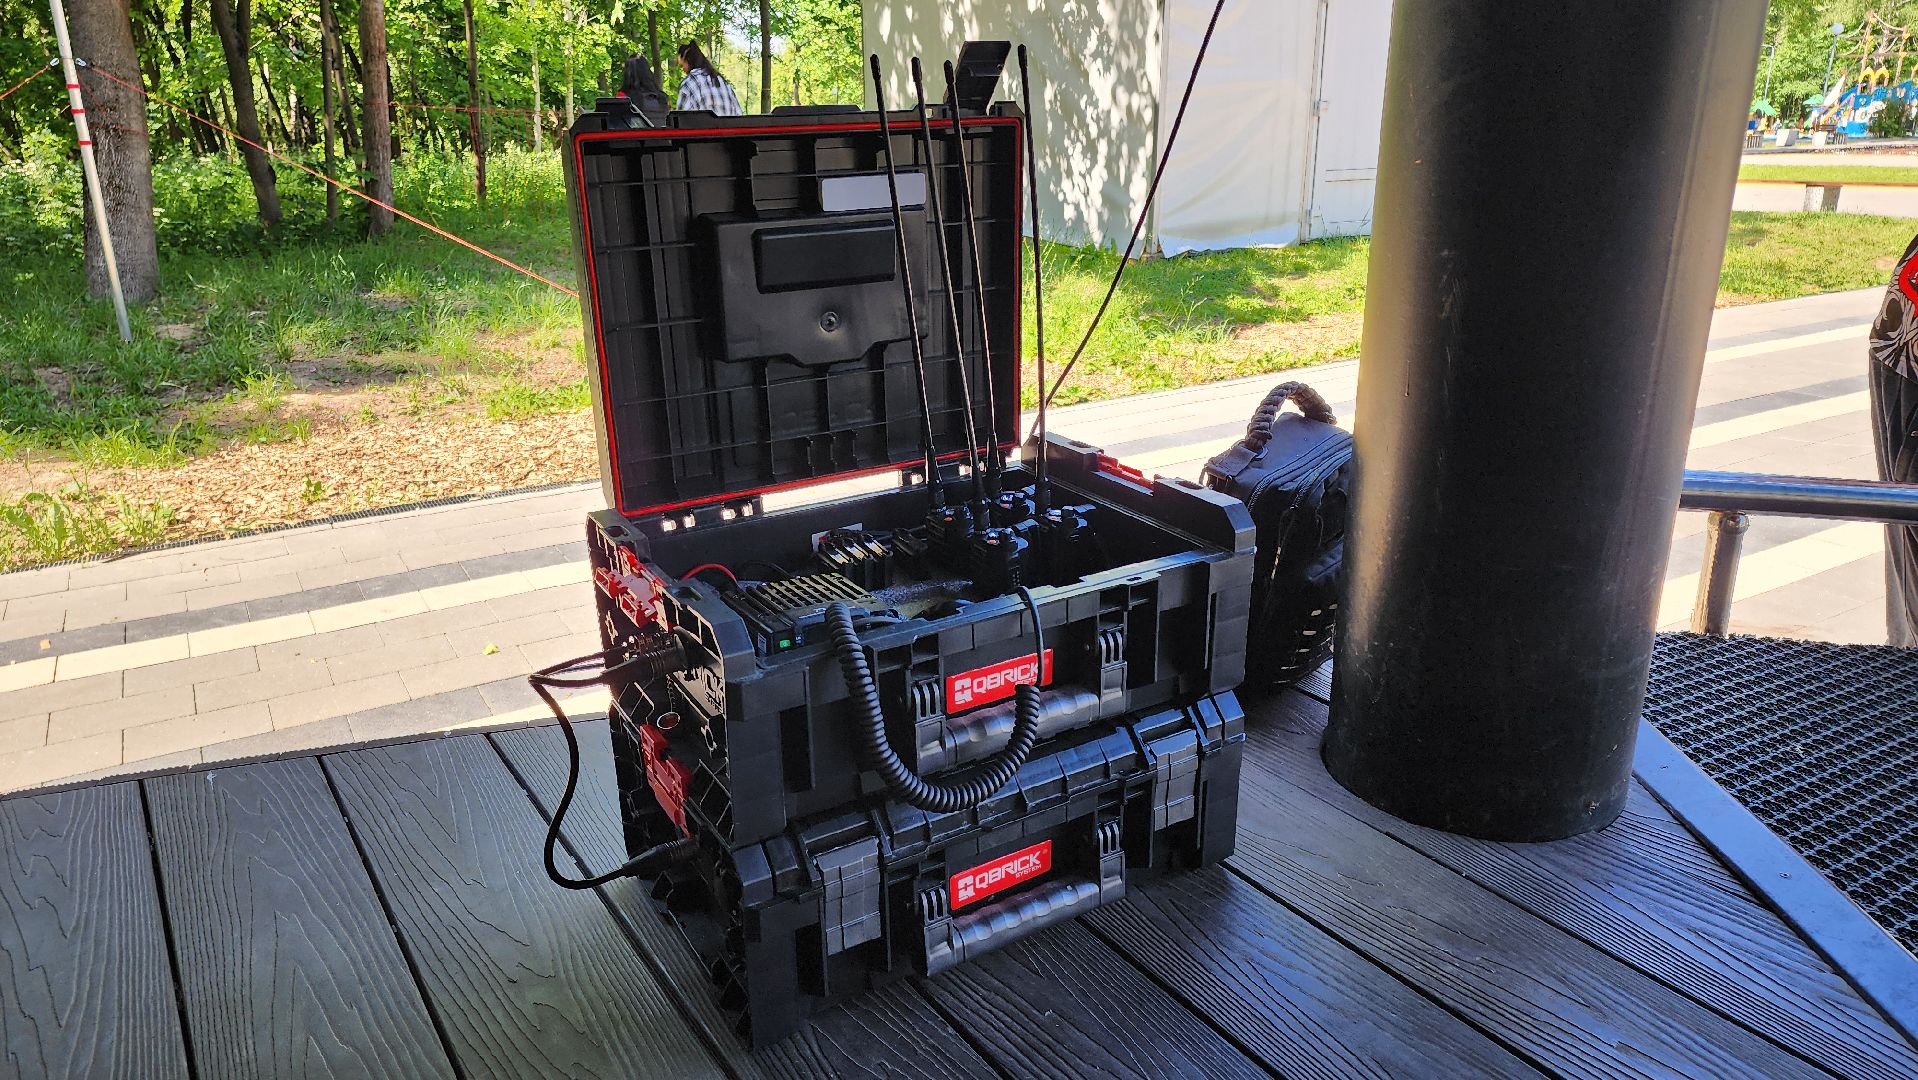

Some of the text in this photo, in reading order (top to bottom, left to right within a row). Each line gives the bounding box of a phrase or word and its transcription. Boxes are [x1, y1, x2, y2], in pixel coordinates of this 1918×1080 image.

[973, 662, 1038, 694] QBRICK
[975, 850, 1041, 889] QBRICK
[1015, 864, 1042, 879] SYSTEM
